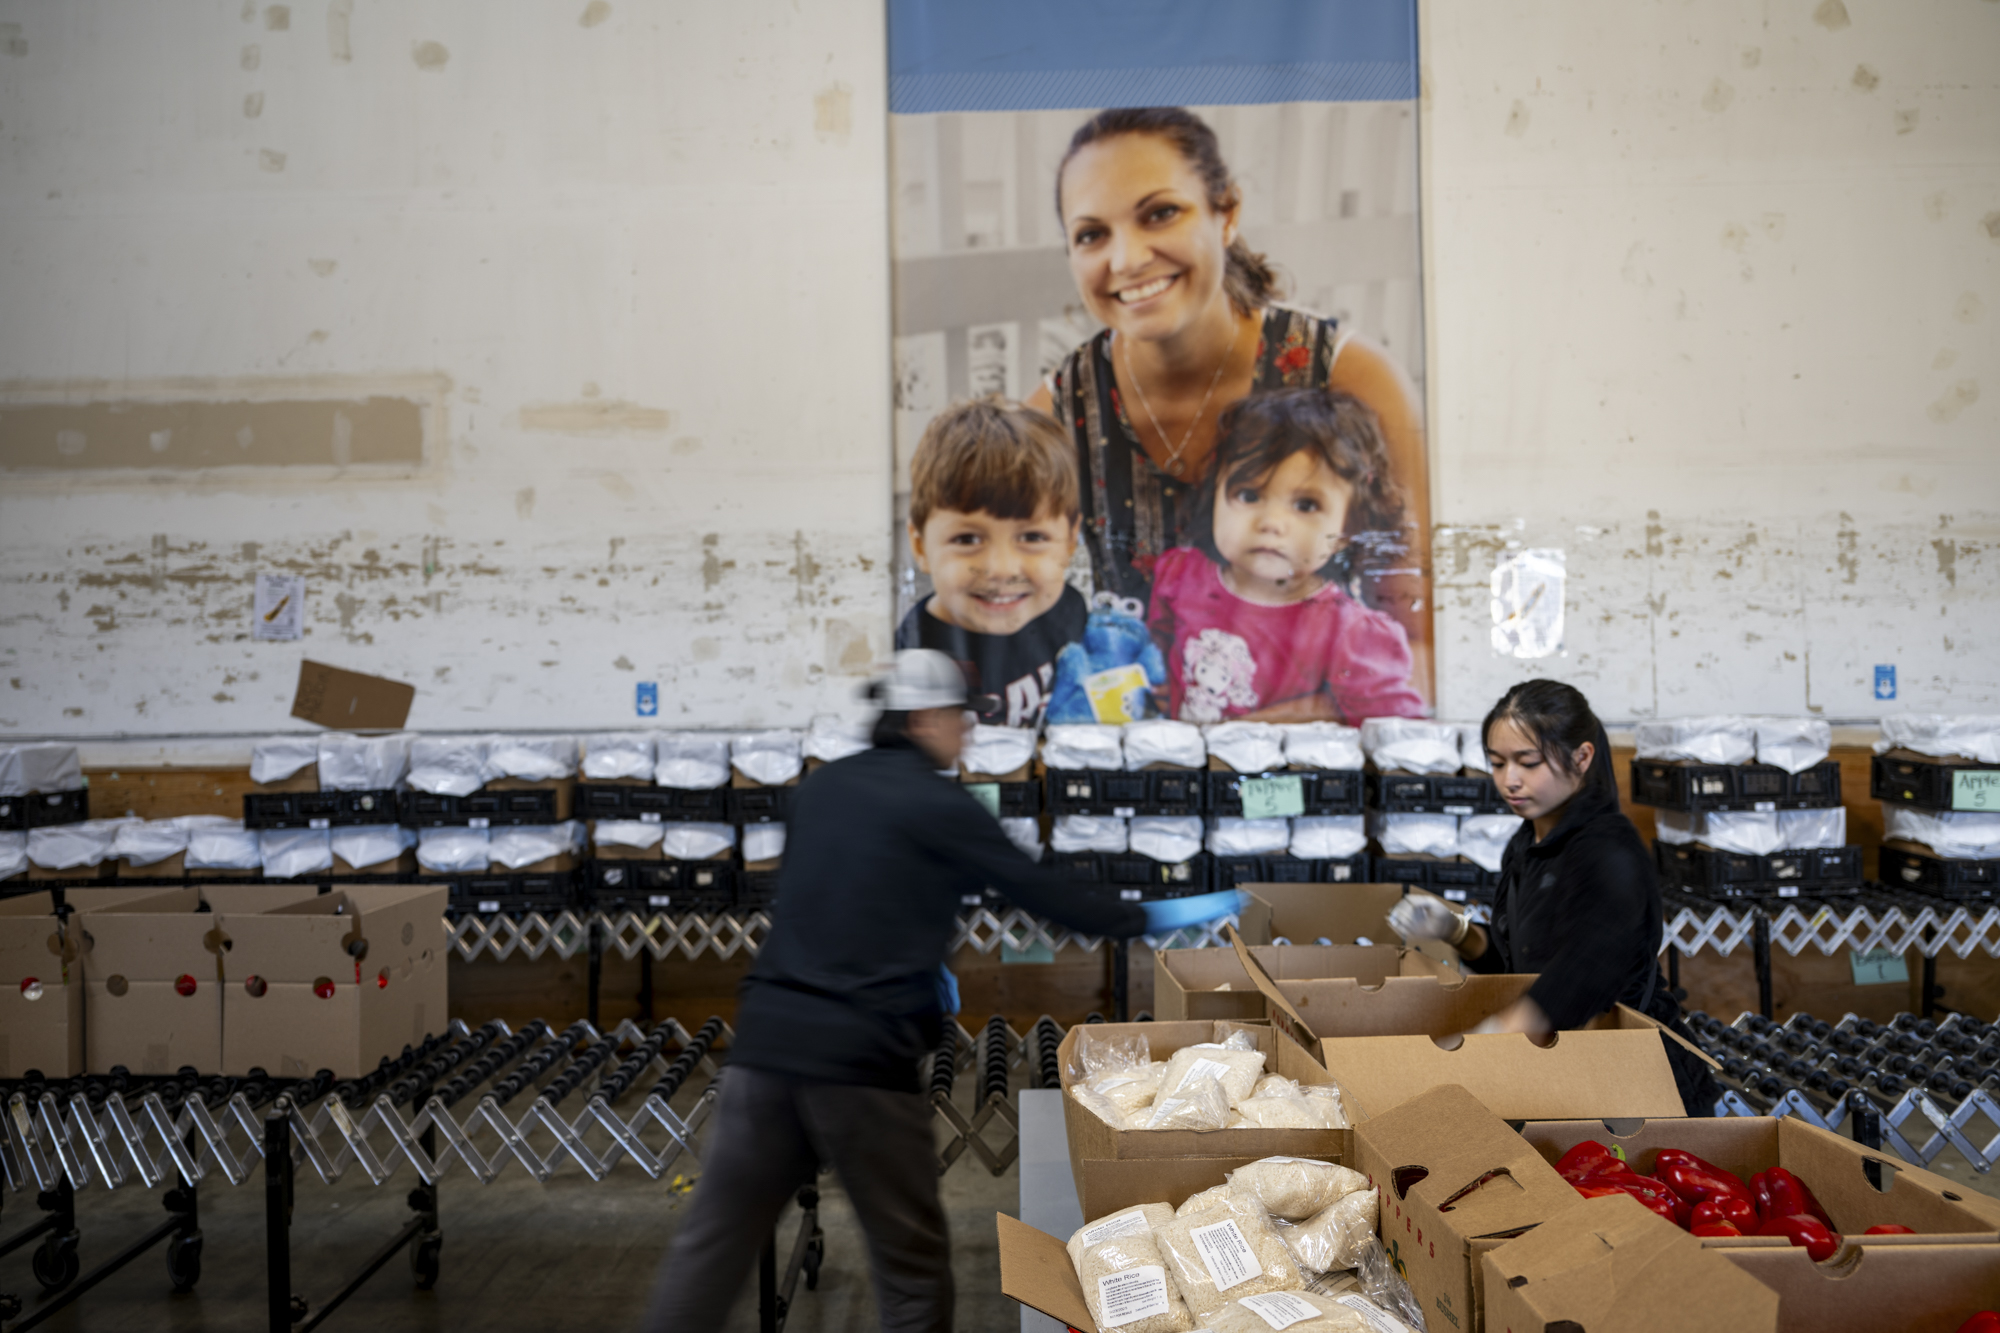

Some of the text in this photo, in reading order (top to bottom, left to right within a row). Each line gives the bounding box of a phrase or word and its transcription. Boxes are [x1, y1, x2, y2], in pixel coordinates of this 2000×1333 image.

[1974, 790, 1986, 807] 5
[1227, 1223, 1246, 1253] White Rice
[1102, 1277, 1122, 1286] White
